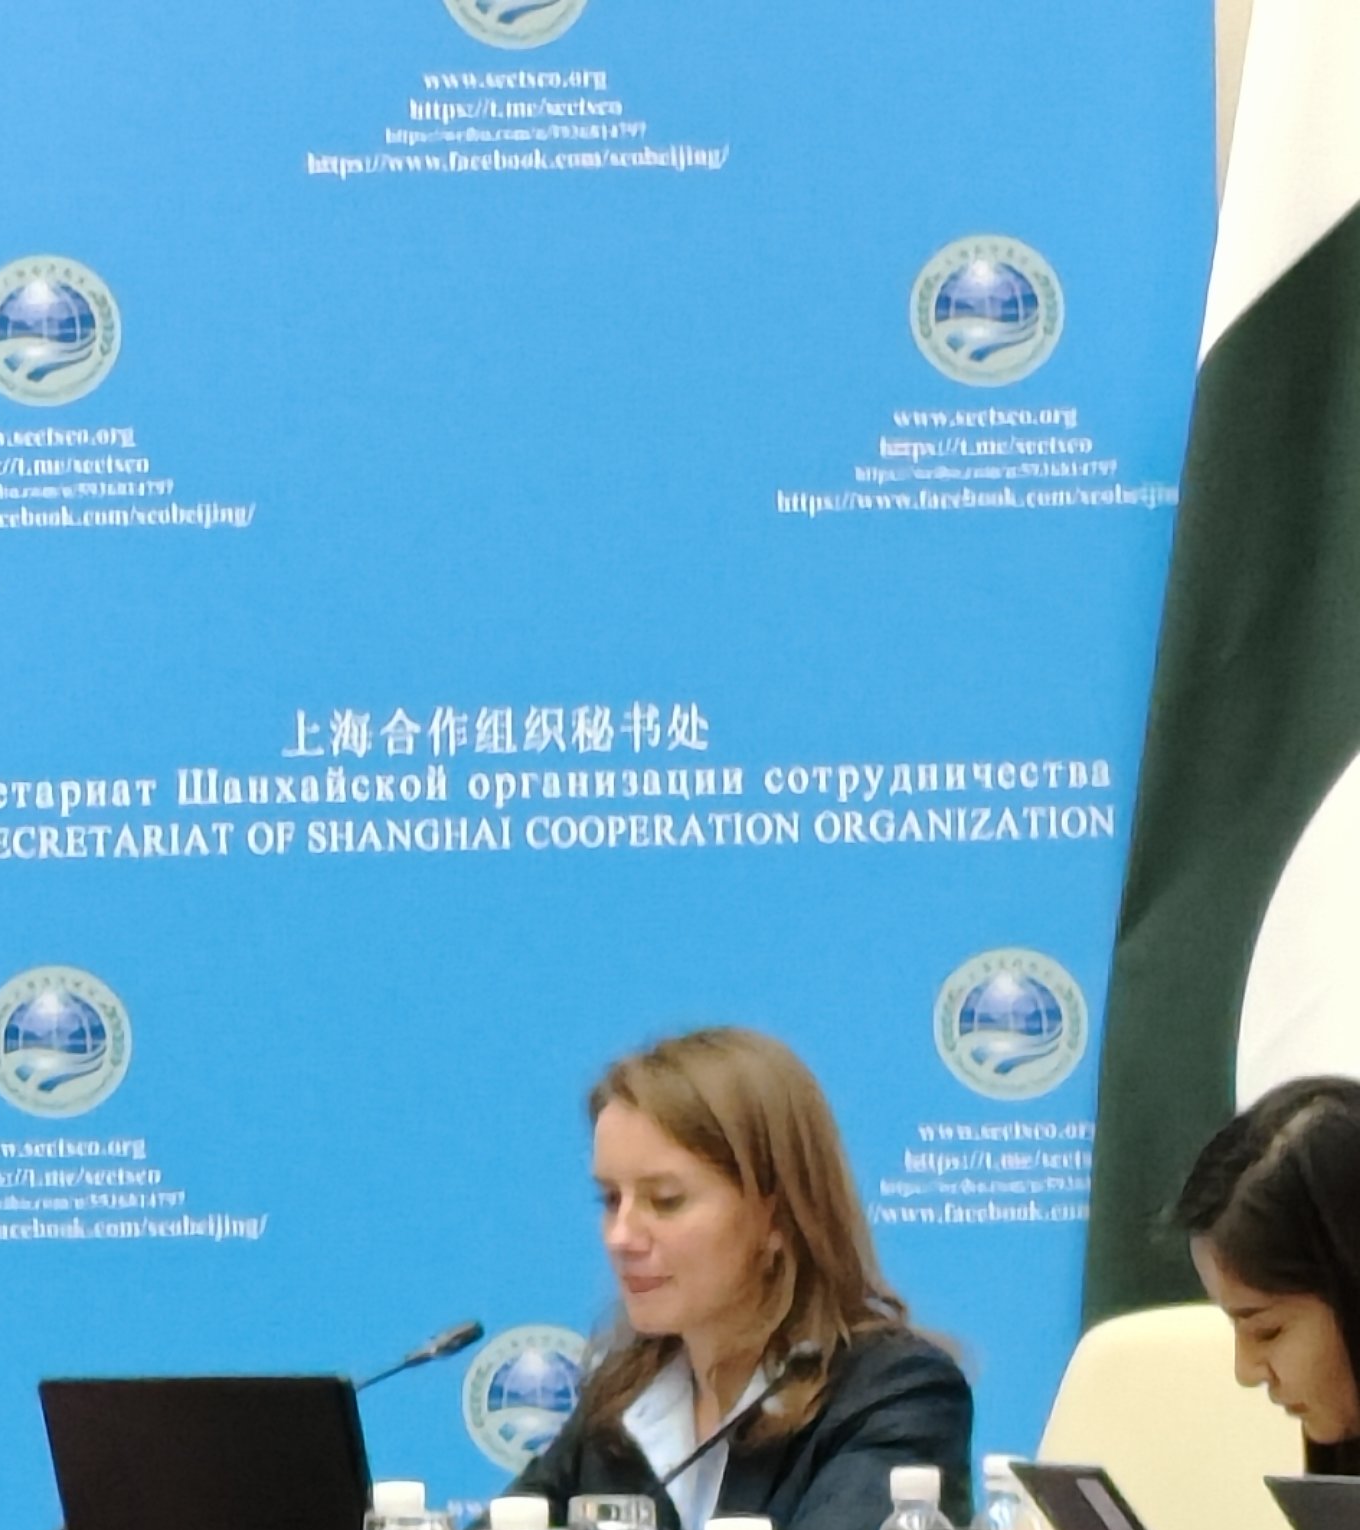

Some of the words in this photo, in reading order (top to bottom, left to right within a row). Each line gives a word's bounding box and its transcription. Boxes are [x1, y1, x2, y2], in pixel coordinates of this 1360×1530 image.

[422, 70, 610, 92] www.sectsco.org
[304, 144, 732, 182] https://www.facebook.com/scobeijing/
[892, 407, 1080, 430] www.sectsco.org
[282, 700, 711, 759] 上海合作组织秘书处
[177, 764, 448, 808] Шанхайской
[469, 765, 745, 812] организации
[764, 758, 1114, 804] сотрудничества
[247, 821, 296, 857] OF
[308, 816, 513, 855] SHANGHAI
[526, 811, 801, 852] COOPERATION
[814, 804, 1116, 846] ORGANIZATION
